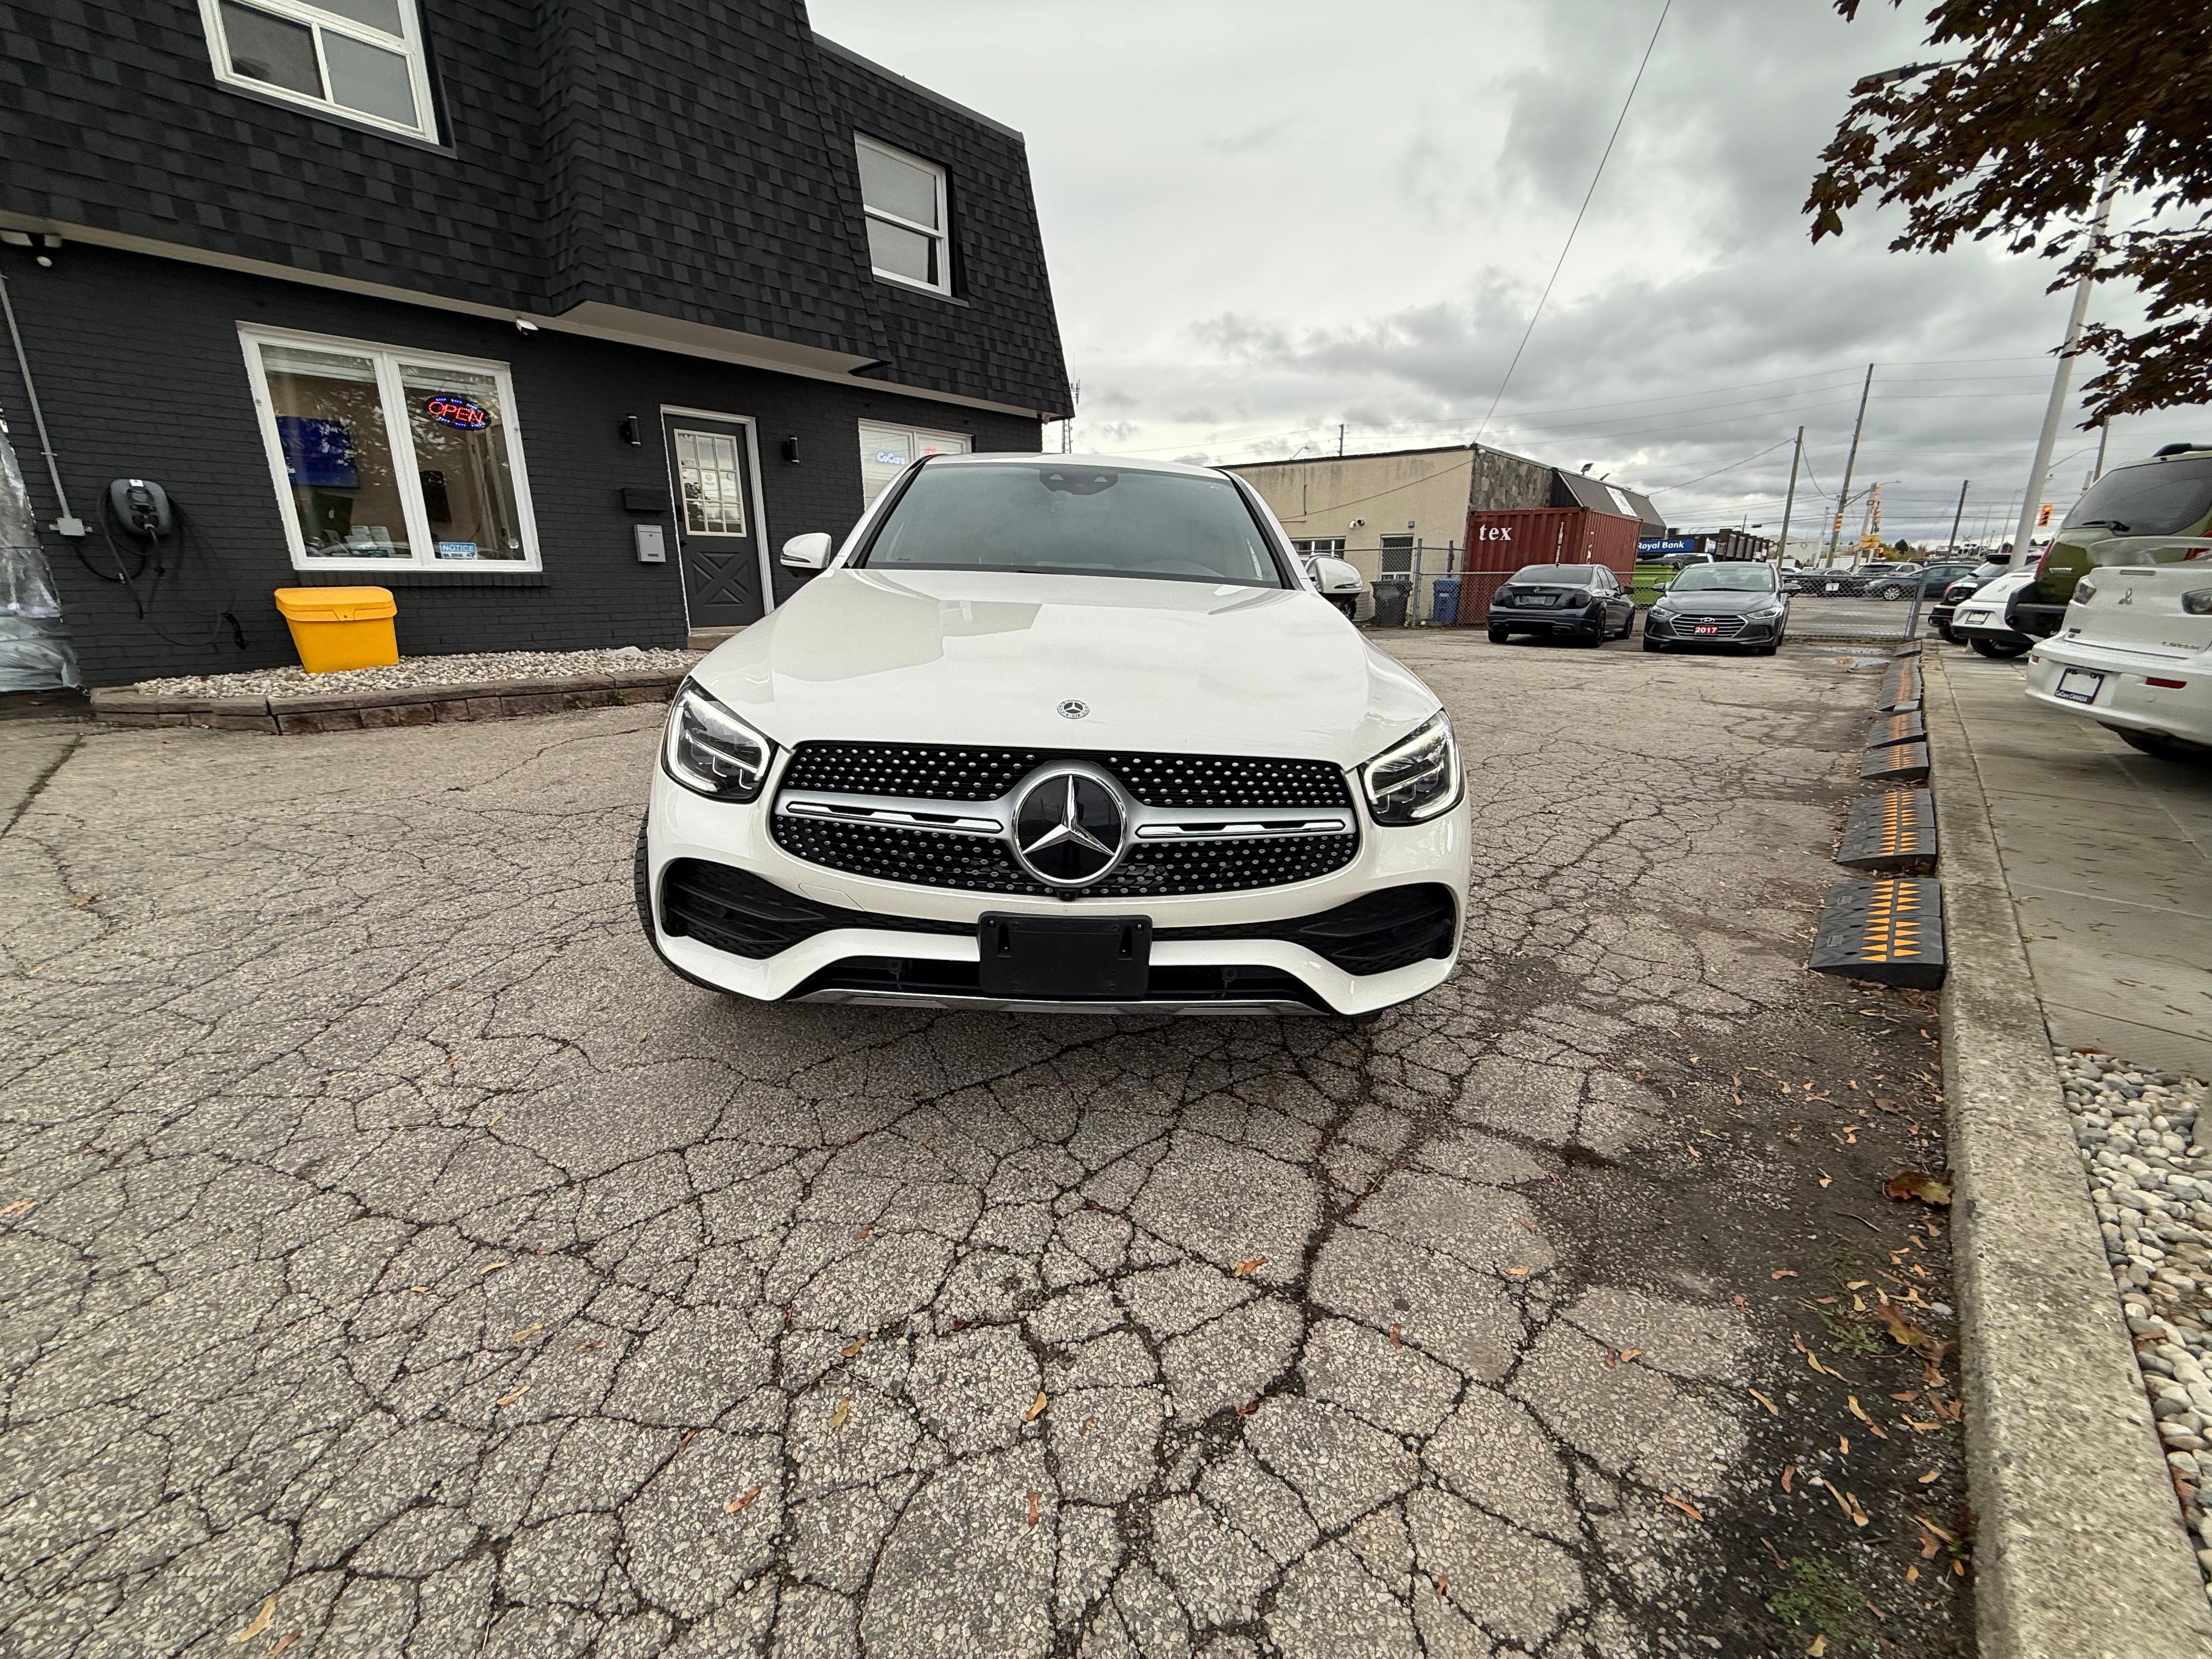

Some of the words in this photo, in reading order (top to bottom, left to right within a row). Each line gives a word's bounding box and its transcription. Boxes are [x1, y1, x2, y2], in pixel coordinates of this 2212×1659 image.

[428, 402, 484, 425] OPEN
[1479, 524, 1513, 541] tex
[1638, 541, 1660, 551] Royal
[1662, 540, 1685, 549] Bank
